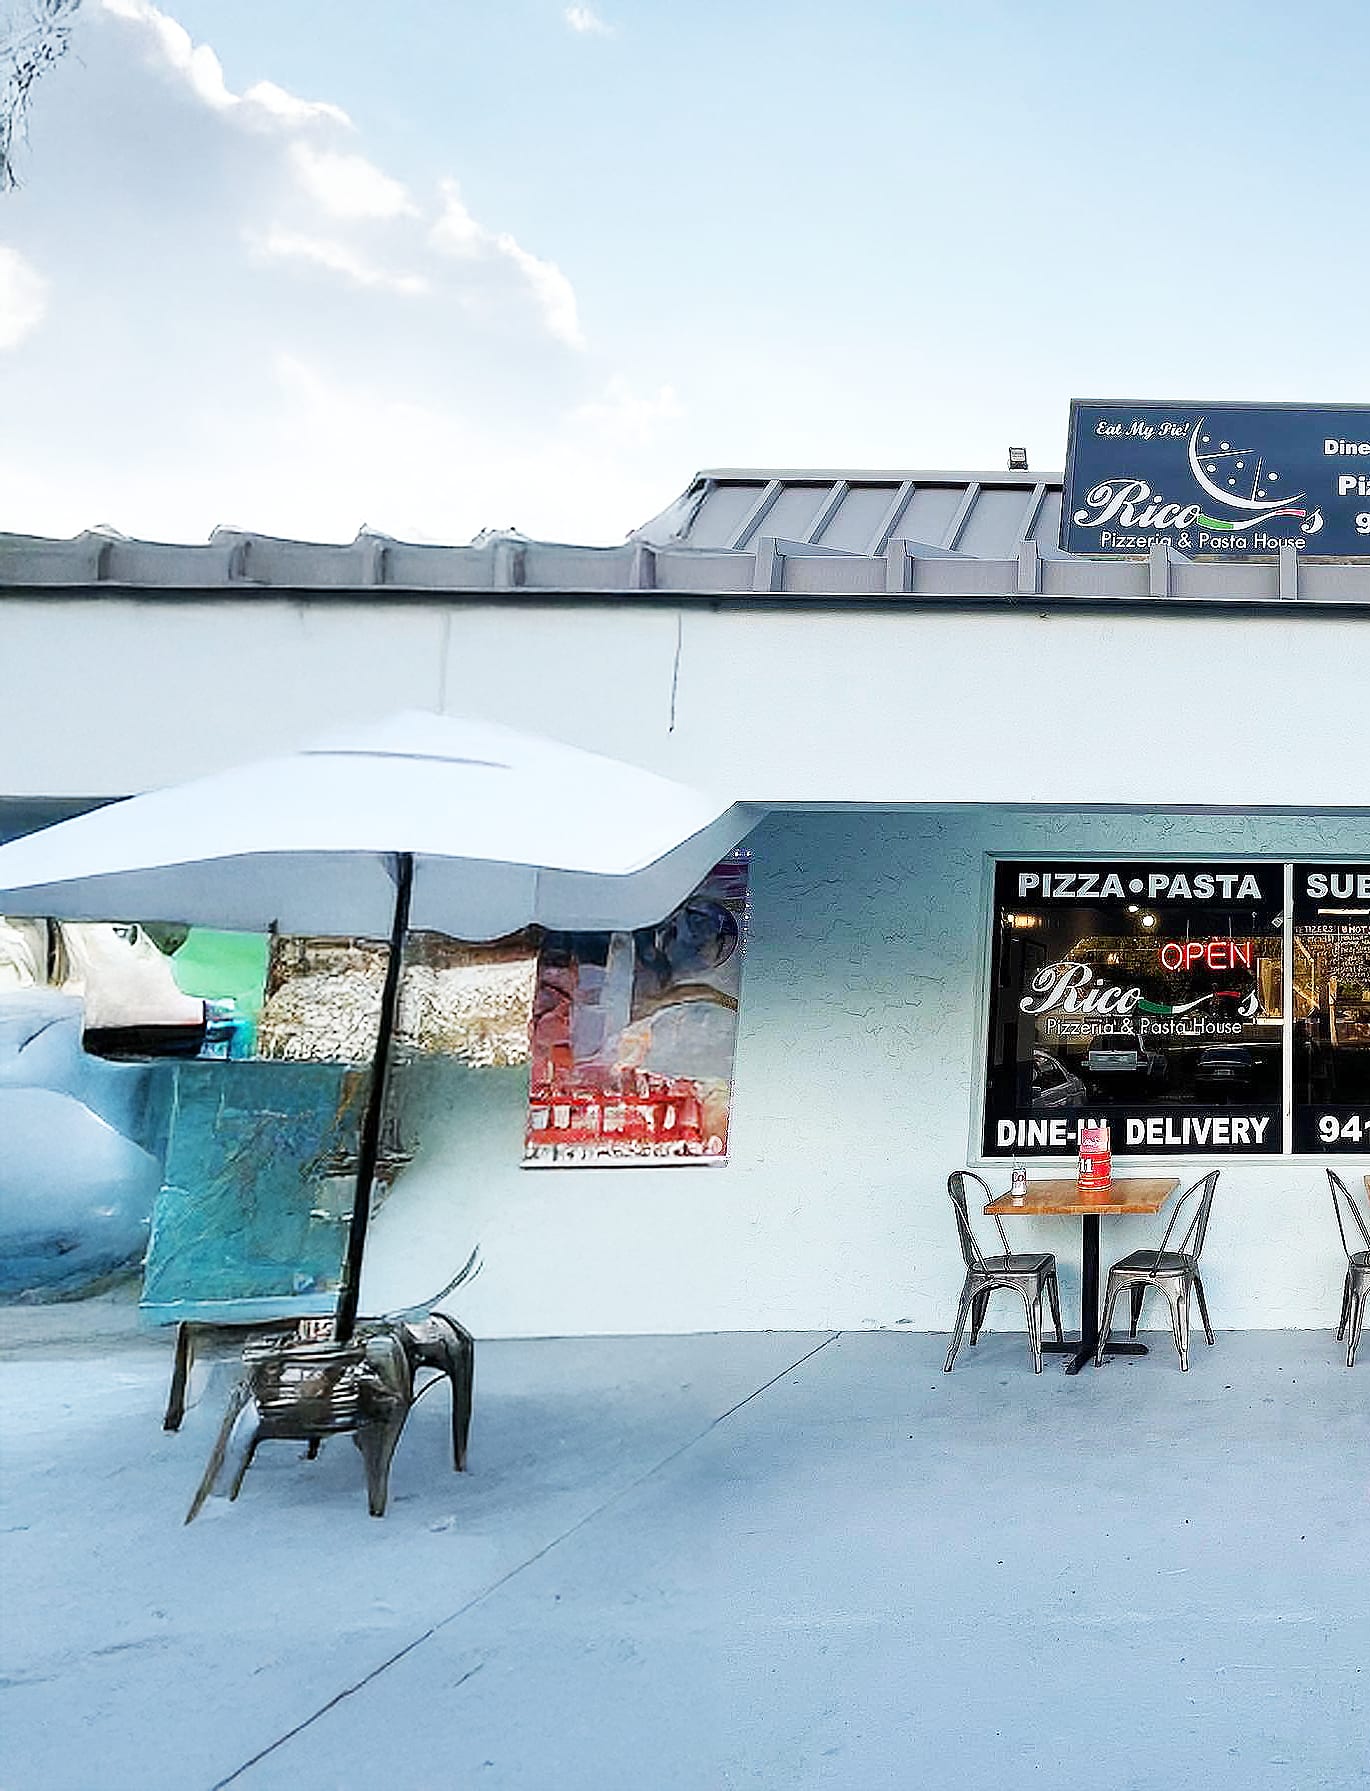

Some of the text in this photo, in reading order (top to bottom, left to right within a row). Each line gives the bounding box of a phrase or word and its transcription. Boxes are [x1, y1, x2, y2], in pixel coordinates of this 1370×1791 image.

[1096, 421, 1190, 440] Eat My Pie!
[1101, 532, 1306, 549] Pizzeria & Pasta House
[1018, 873, 1262, 899] PIZZA PASTA
[1161, 941, 1251, 970] OPEN
[1046, 1018, 1242, 1035] Pizzeria & Pasta House
[1126, 1117, 1270, 1145] DELIVERY
